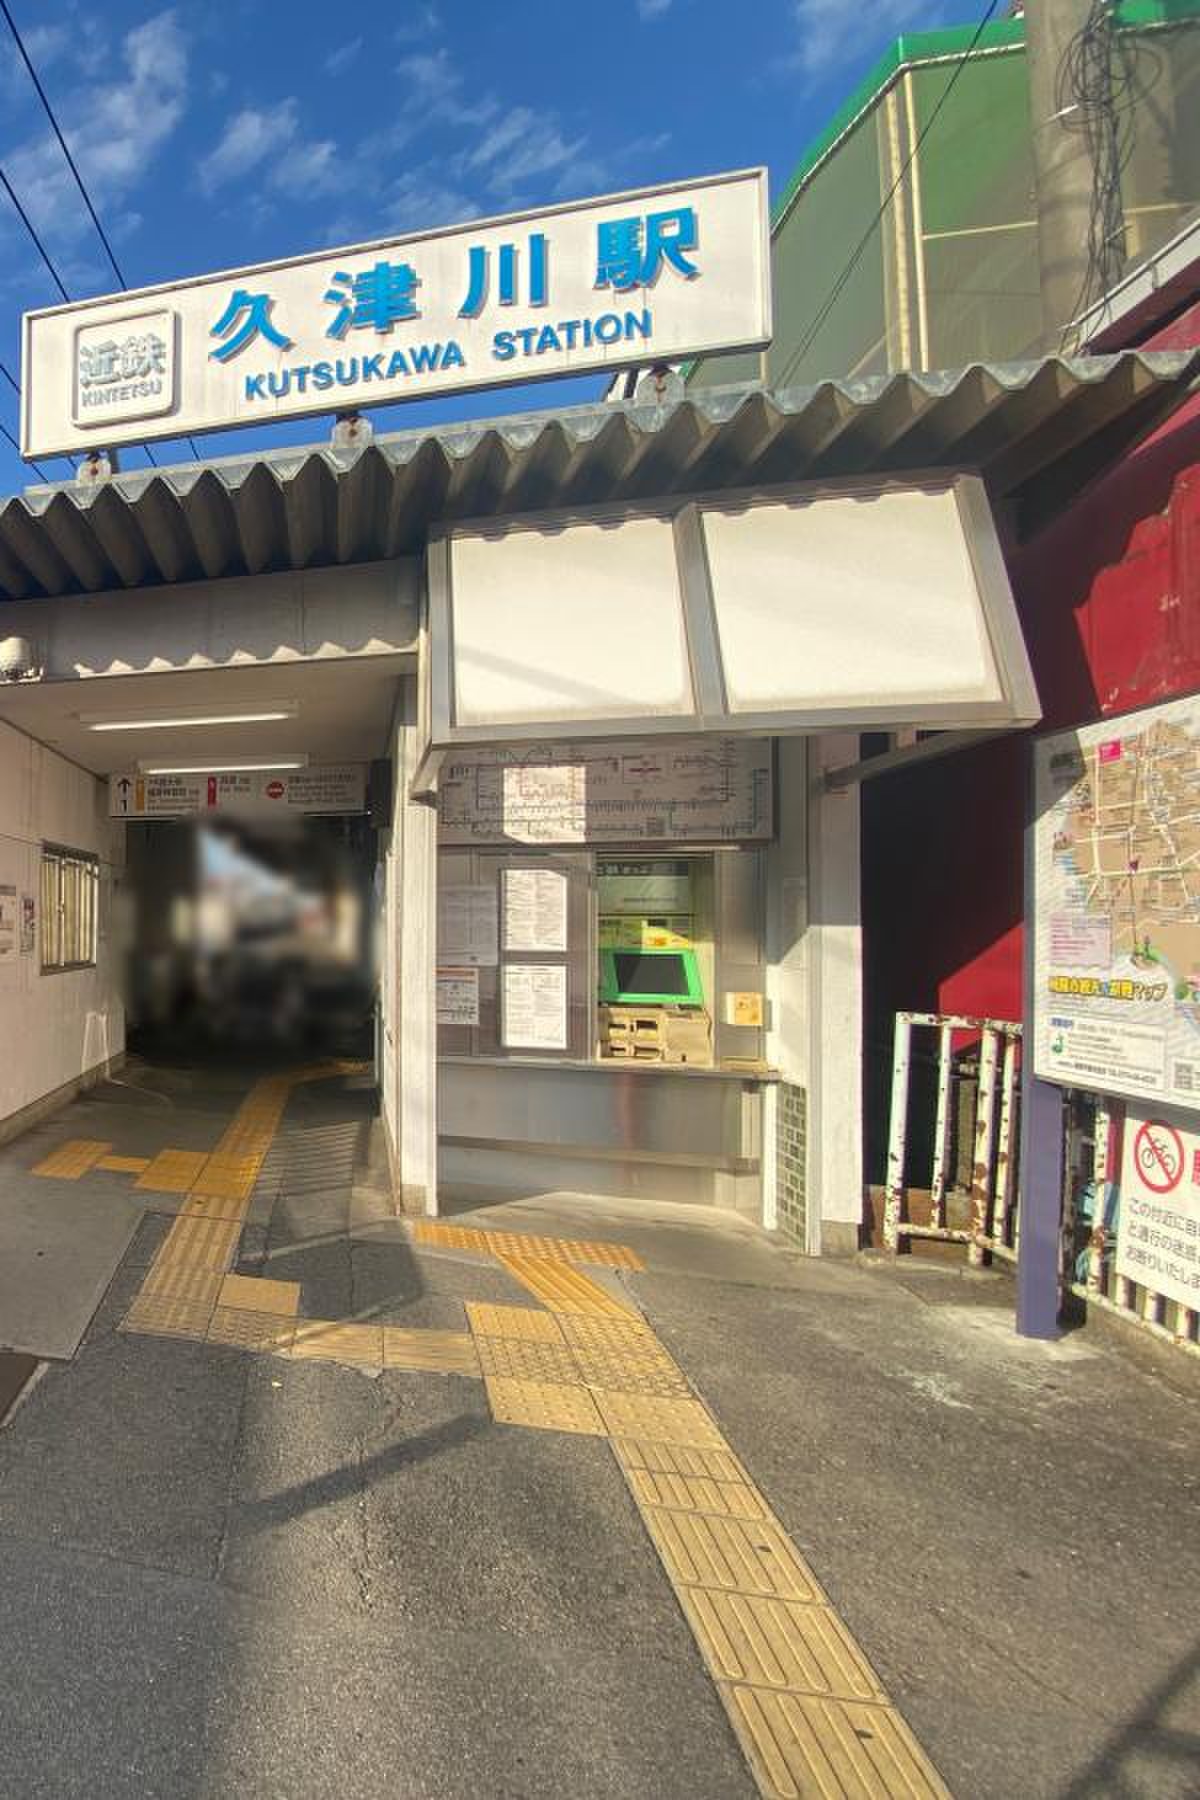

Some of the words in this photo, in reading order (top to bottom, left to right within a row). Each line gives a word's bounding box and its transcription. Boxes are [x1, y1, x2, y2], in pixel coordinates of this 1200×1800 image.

[208, 207, 698, 362] 久津川駅
[82, 380, 162, 407] KINTETSU
[245, 340, 465, 400] KUTSUKAWA
[492, 308, 652, 361] STATION
